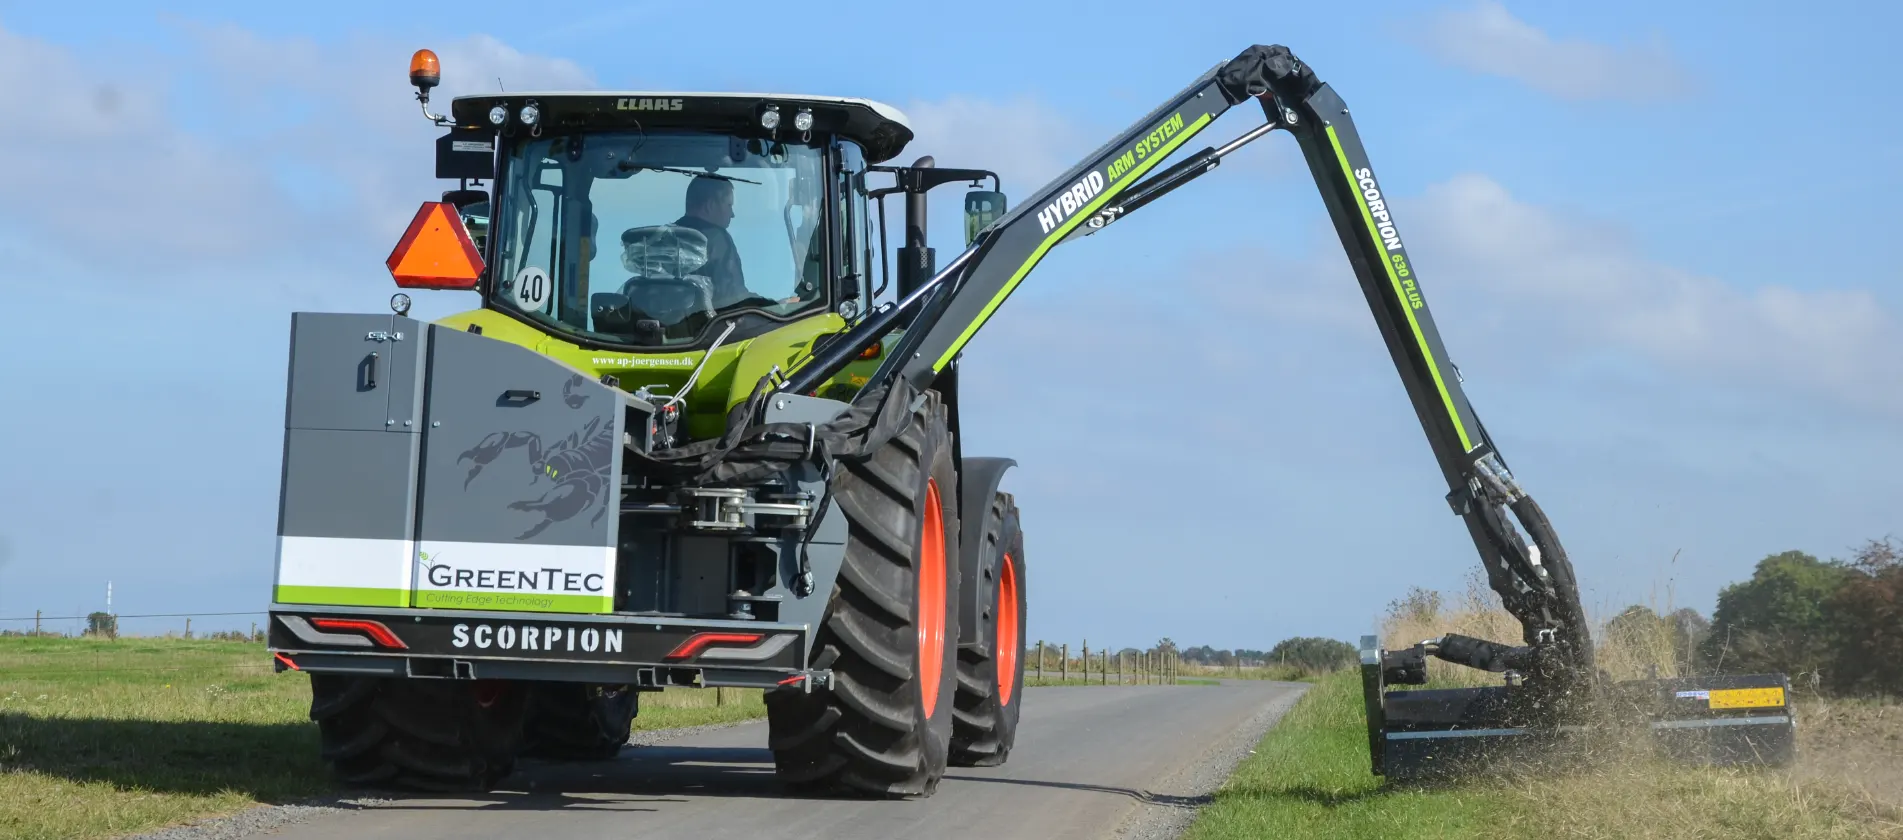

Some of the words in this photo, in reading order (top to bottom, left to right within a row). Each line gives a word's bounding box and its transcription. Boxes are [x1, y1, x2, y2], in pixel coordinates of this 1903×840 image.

[617, 98, 683, 111] CLAAS
[1037, 170, 1104, 234] HYBRID
[1107, 150, 1136, 183] ARM
[1135, 112, 1184, 159] SYSTEM
[1355, 167, 1402, 251] SCORPION
[1392, 254, 1410, 277] 630
[1403, 279, 1423, 310] PLUS
[520, 274, 543, 303] 40
[592, 356, 693, 367] wwwap-joergensen.dk
[426, 593, 463, 605] Cutting
[466, 594, 493, 605] Edge
[496, 595, 554, 608] Technology
[452, 623, 623, 653] SCORPION
